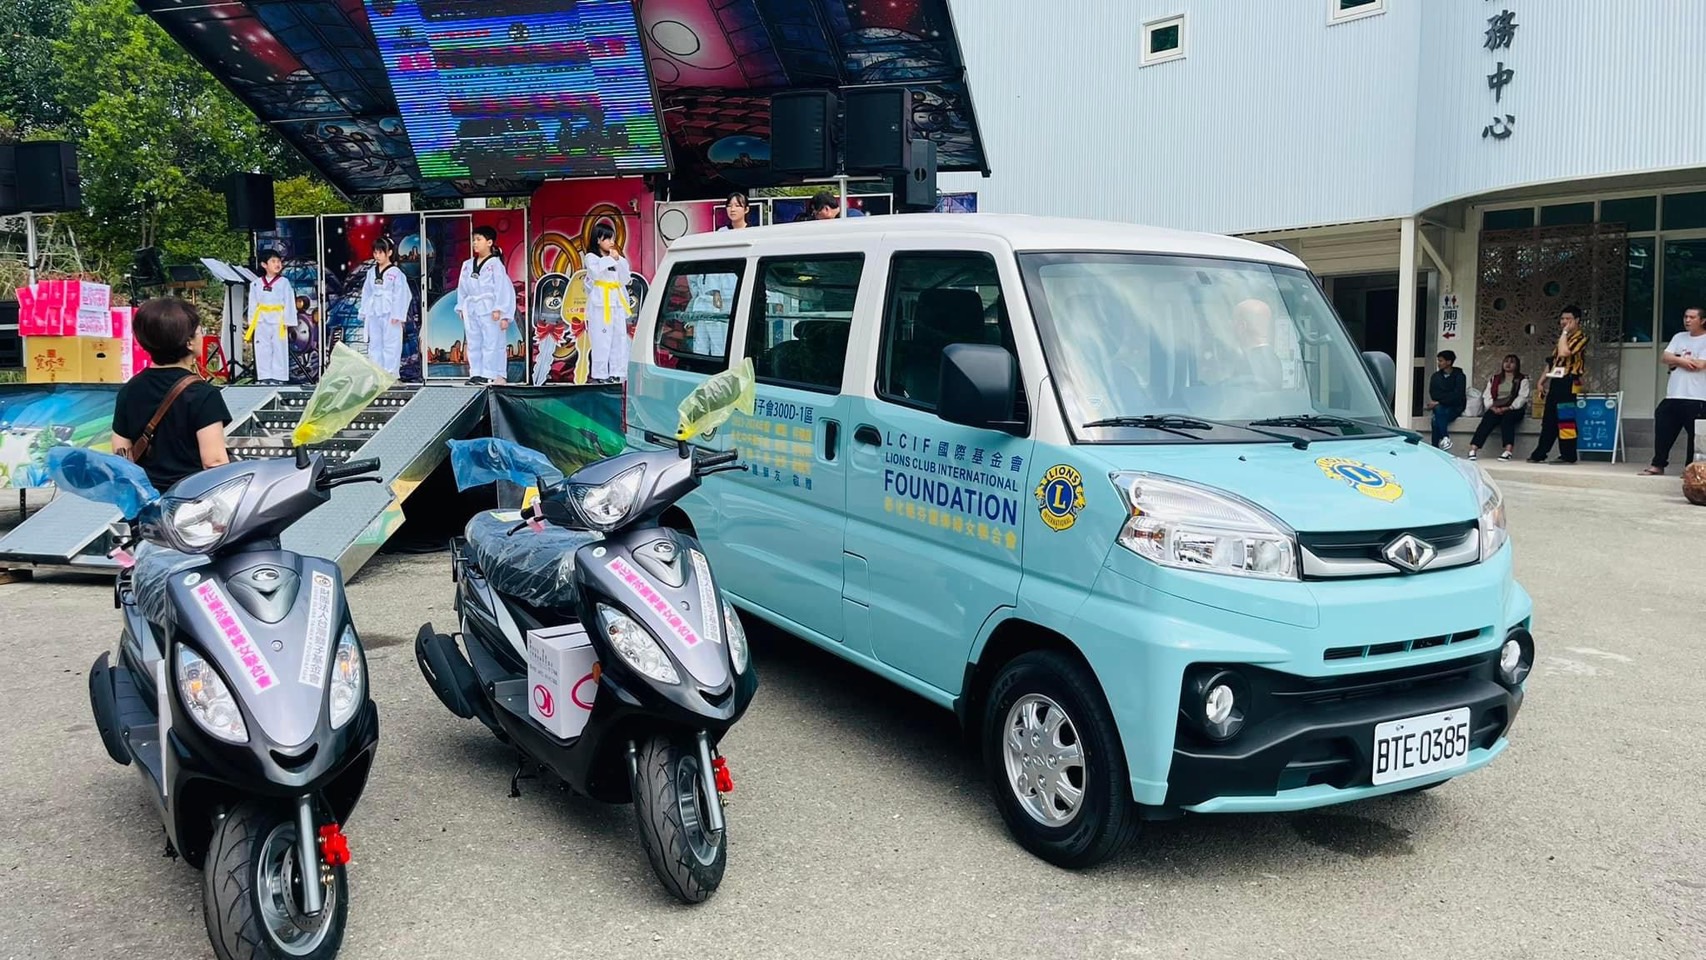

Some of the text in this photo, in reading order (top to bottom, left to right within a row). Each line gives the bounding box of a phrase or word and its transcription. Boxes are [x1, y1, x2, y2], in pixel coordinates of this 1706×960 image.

[1482, 0, 1519, 140] 務中心
[1443, 310, 1458, 331] 廁所
[754, 398, 814, 424] 子會300D-1區
[938, 441, 1024, 473] 國際基金會
[885, 452, 1019, 492] LIONS CLUB INTERNATIONAL
[1049, 467, 1079, 484] LIONS
[884, 469, 1018, 526] FOUNDATION
[1052, 484, 1066, 509] L
